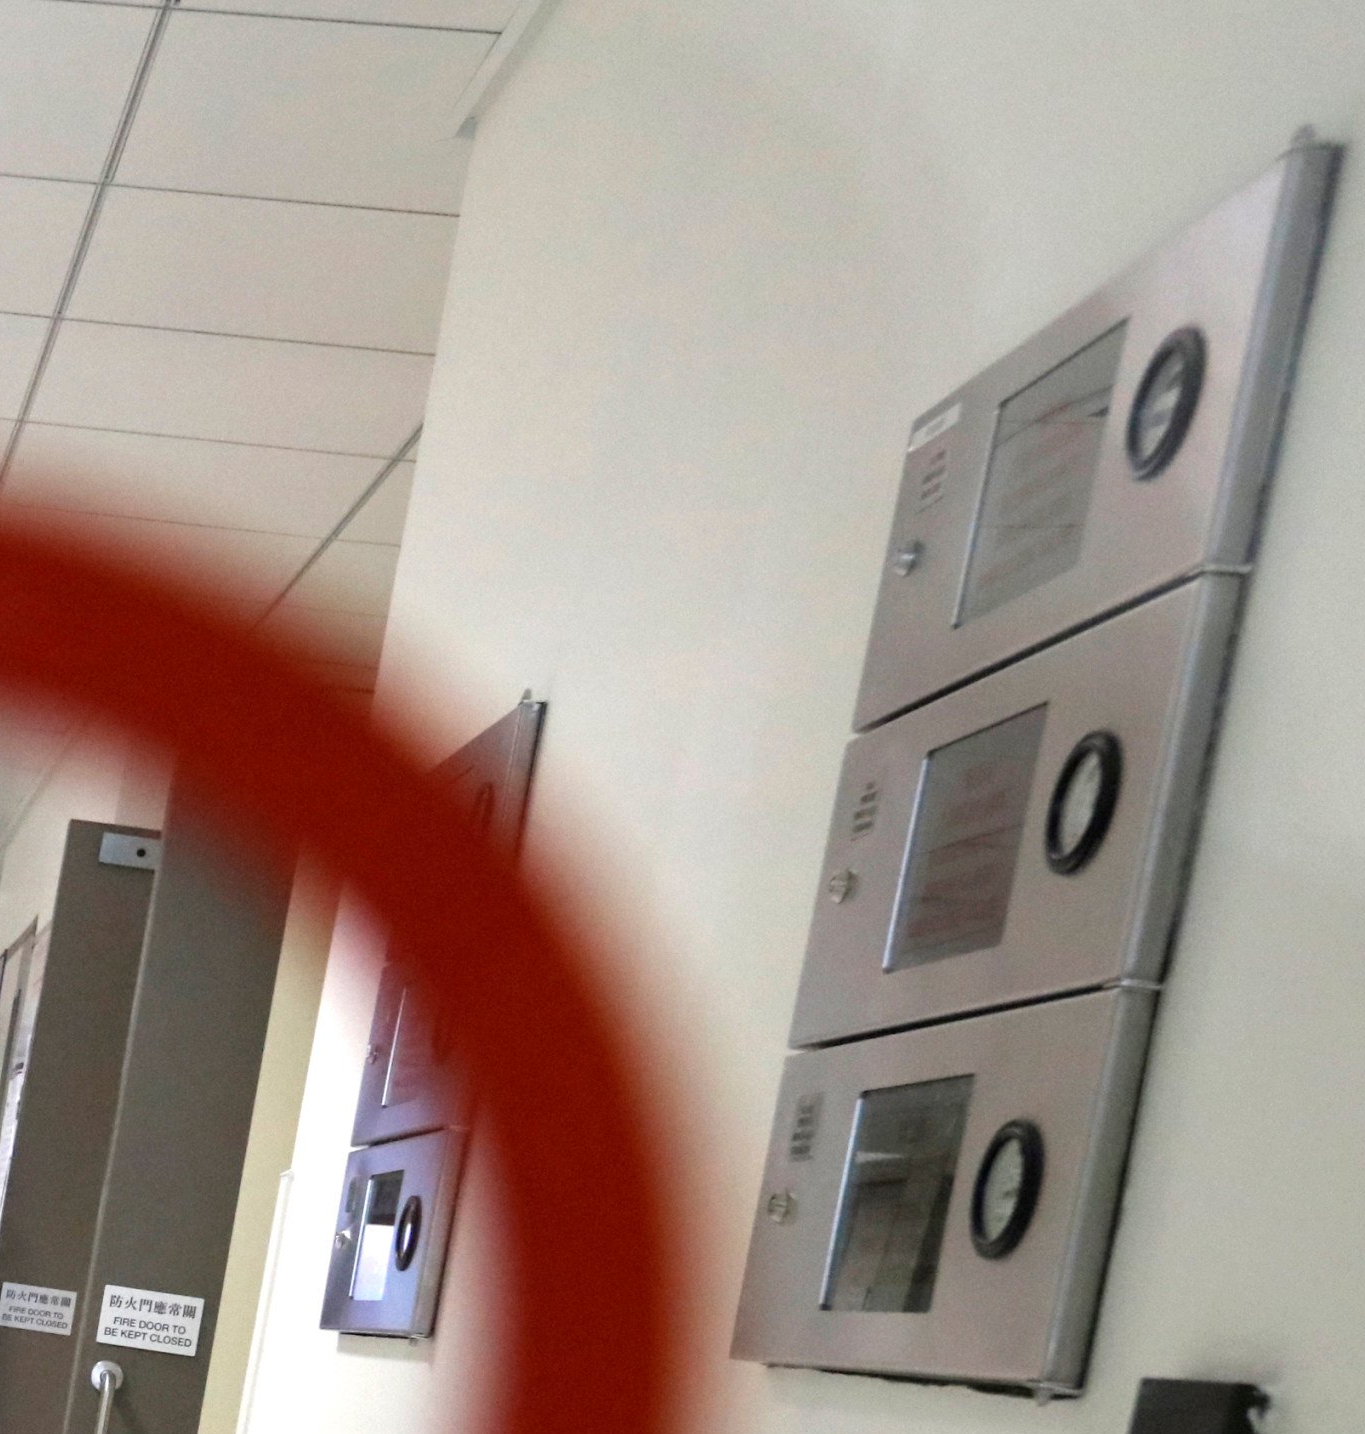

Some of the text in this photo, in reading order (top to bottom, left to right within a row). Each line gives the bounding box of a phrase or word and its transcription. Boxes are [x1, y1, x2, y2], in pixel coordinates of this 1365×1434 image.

[9, 1305, 64, 1320] FIRE DOOR TO
[109, 1294, 197, 1319] 防火門應常關
[2, 1313, 68, 1329] BE KEPT CLOSED
[113, 1316, 187, 1335] FIRE DOOR TO
[104, 1327, 193, 1347] BE KEPT CLOSED
